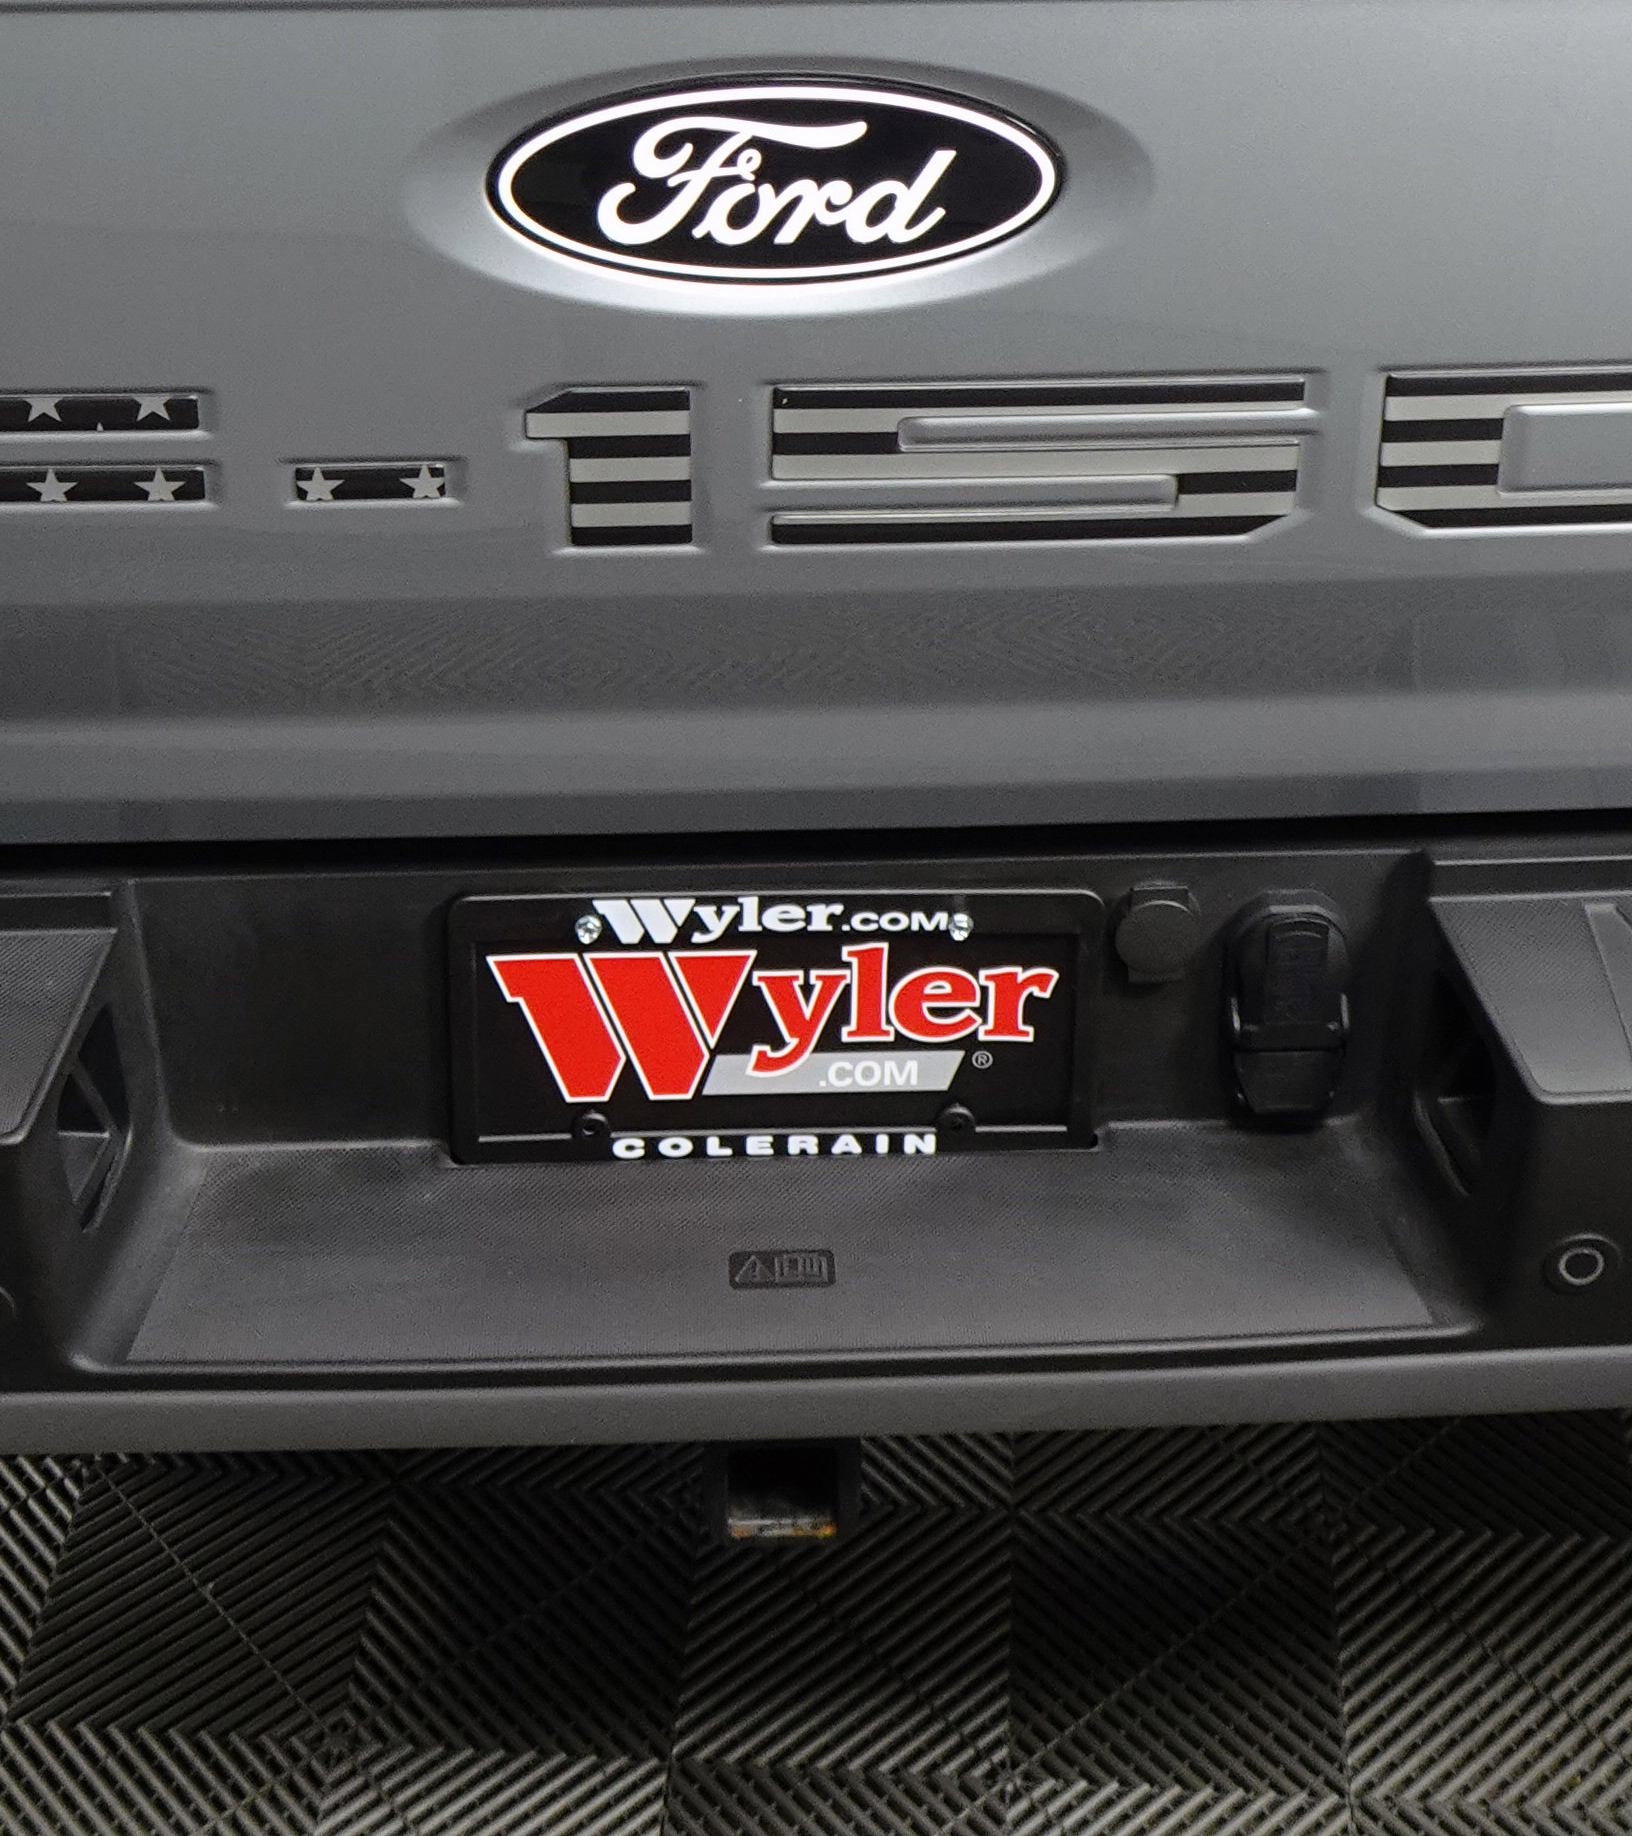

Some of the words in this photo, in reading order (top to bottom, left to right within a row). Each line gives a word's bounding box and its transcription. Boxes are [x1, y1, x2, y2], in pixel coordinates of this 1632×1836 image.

[597, 116, 957, 246] Ford
[486, 942, 1059, 1102] Wyler
[612, 1131, 936, 1159] COLERAIN
